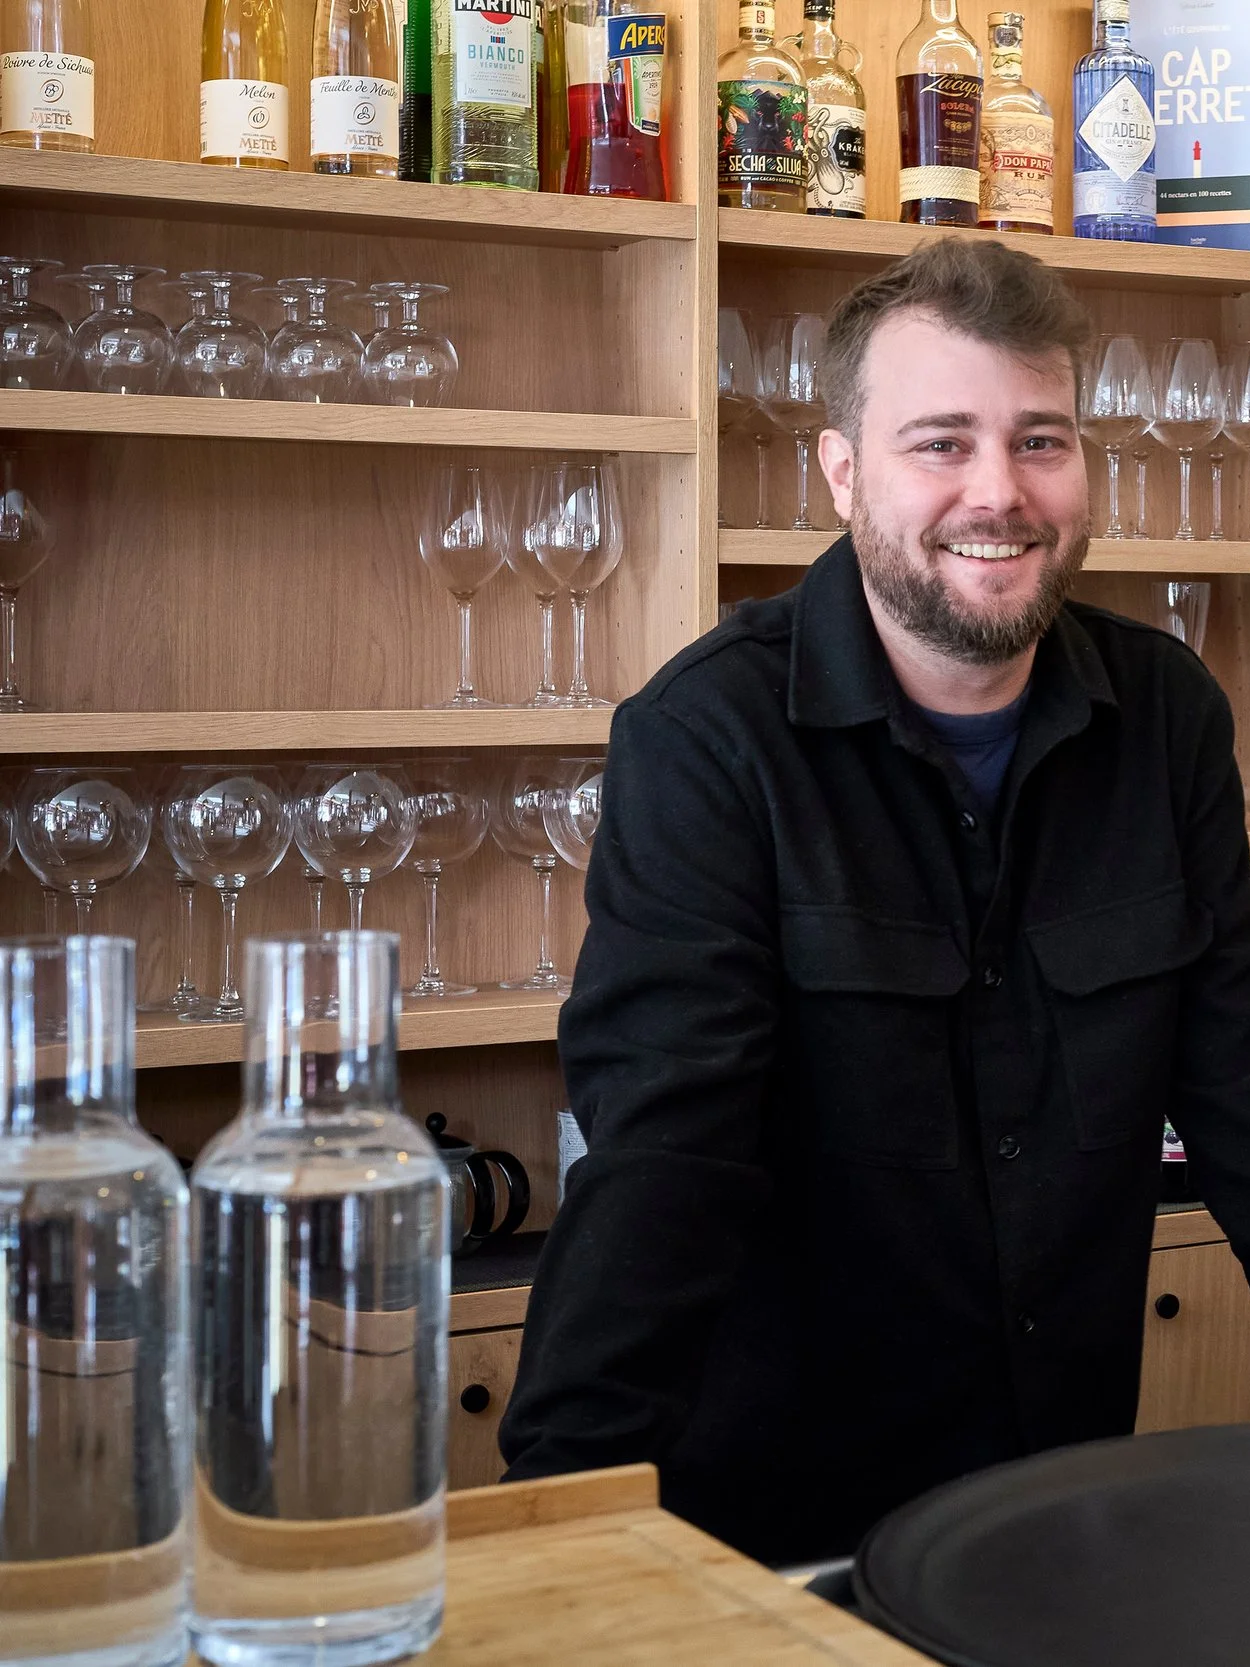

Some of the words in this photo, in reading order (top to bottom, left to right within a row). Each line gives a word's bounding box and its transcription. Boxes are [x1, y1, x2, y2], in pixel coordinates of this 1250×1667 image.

[457, 0, 530, 17] MARTINI
[468, 44, 524, 64] BIANCO
[3, 56, 36, 69] Poivre
[39, 54, 54, 68] de
[480, 62, 515, 70] VERMOUTH
[1162, 46, 1232, 88] CAP
[239, 84, 275, 99] Melon
[320, 79, 353, 93] Feuille
[355, 80, 368, 92] de
[31, 112, 72, 125] METTÉ
[1093, 121, 1152, 141] CITADELLE
[240, 137, 277, 151] METTÉ
[345, 134, 384, 147] METTÉ
[839, 141, 865, 155] KRAKE
[729, 154, 766, 172] SECHA
[776, 156, 802, 176] SILVA
[1004, 156, 1028, 168] DON
[1014, 171, 1046, 181] RUM
